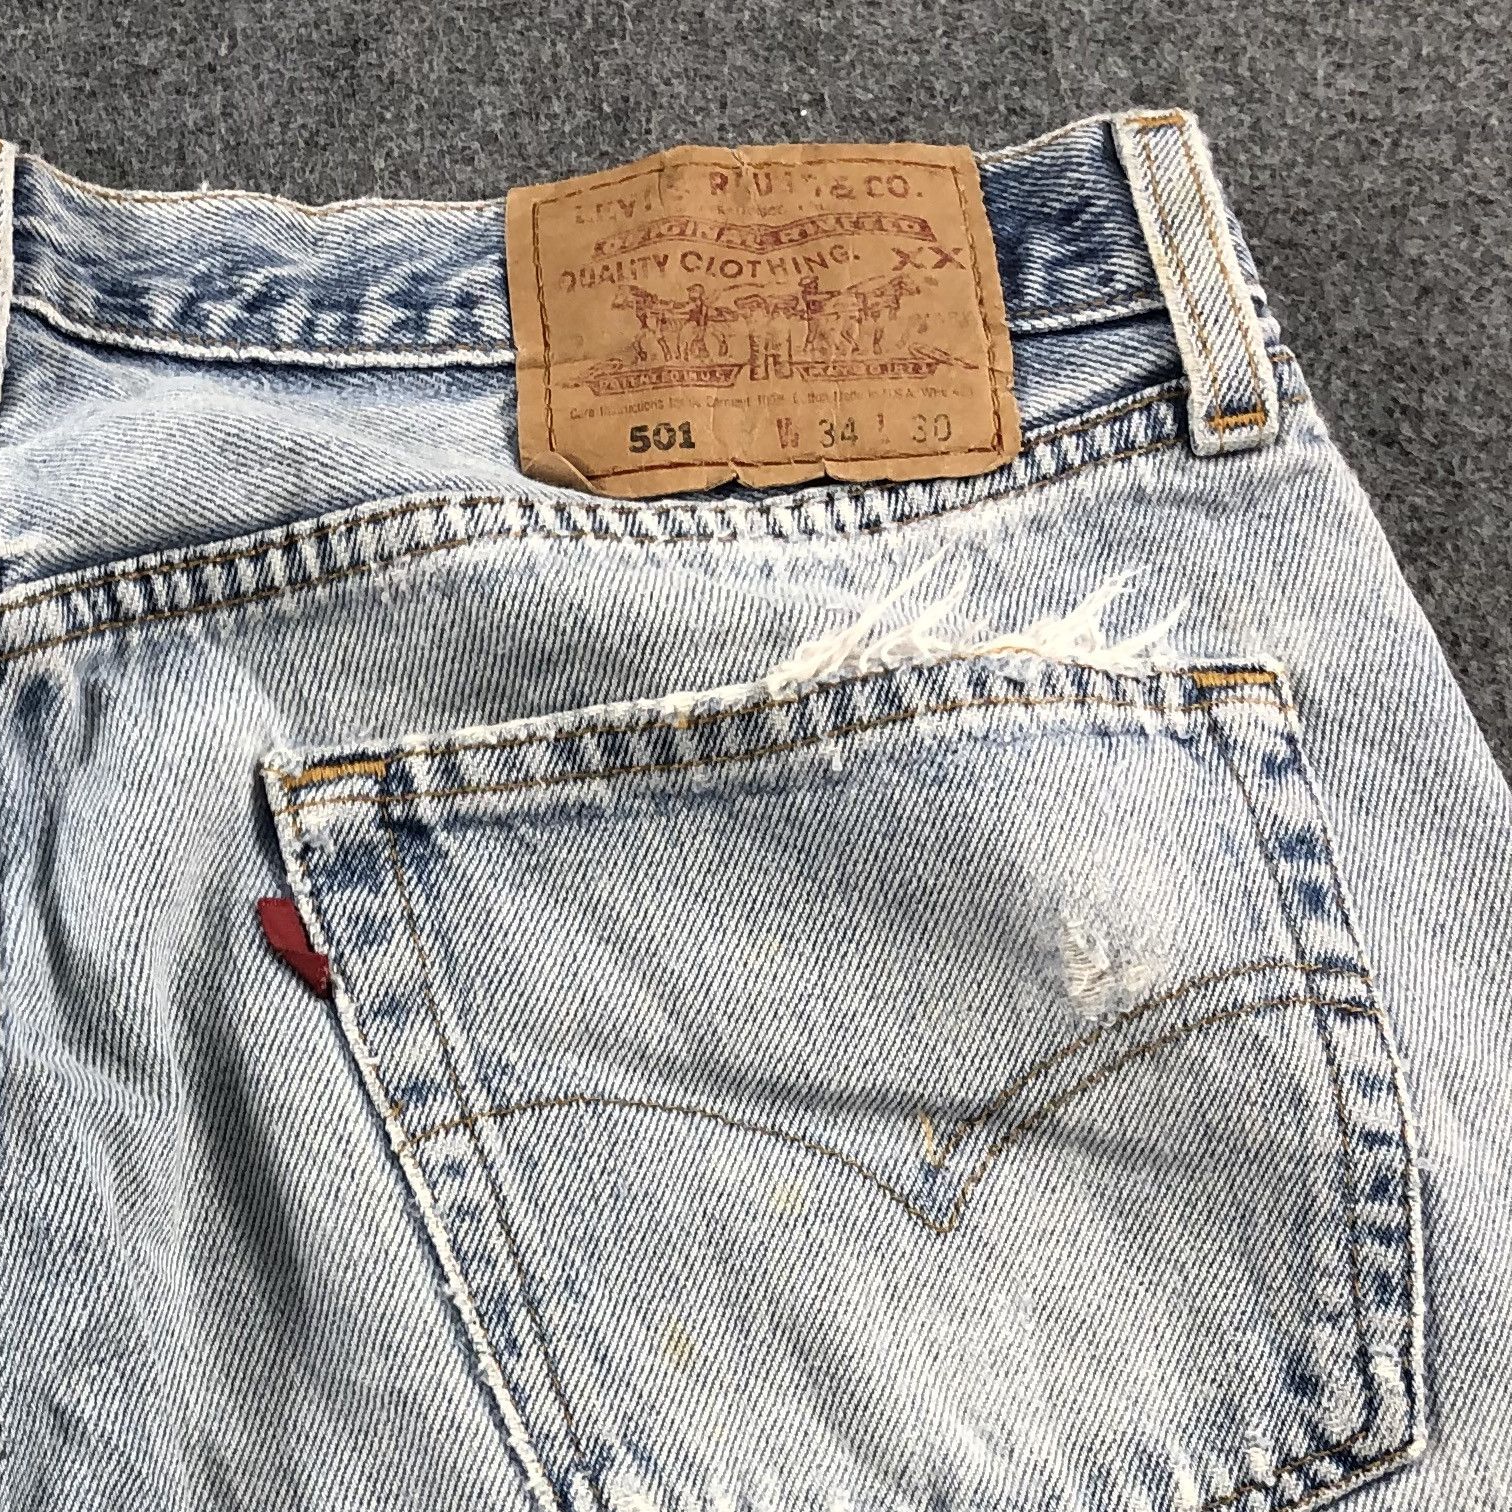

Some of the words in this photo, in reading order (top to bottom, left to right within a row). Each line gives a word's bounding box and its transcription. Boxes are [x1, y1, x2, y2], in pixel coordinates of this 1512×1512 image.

[863, 173, 924, 200] CO.
[559, 253, 670, 294] QUALITY
[679, 243, 861, 279] CLOTHING.
[628, 420, 696, 454] 501
[818, 416, 859, 449] 34
[911, 412, 953, 444] 30
